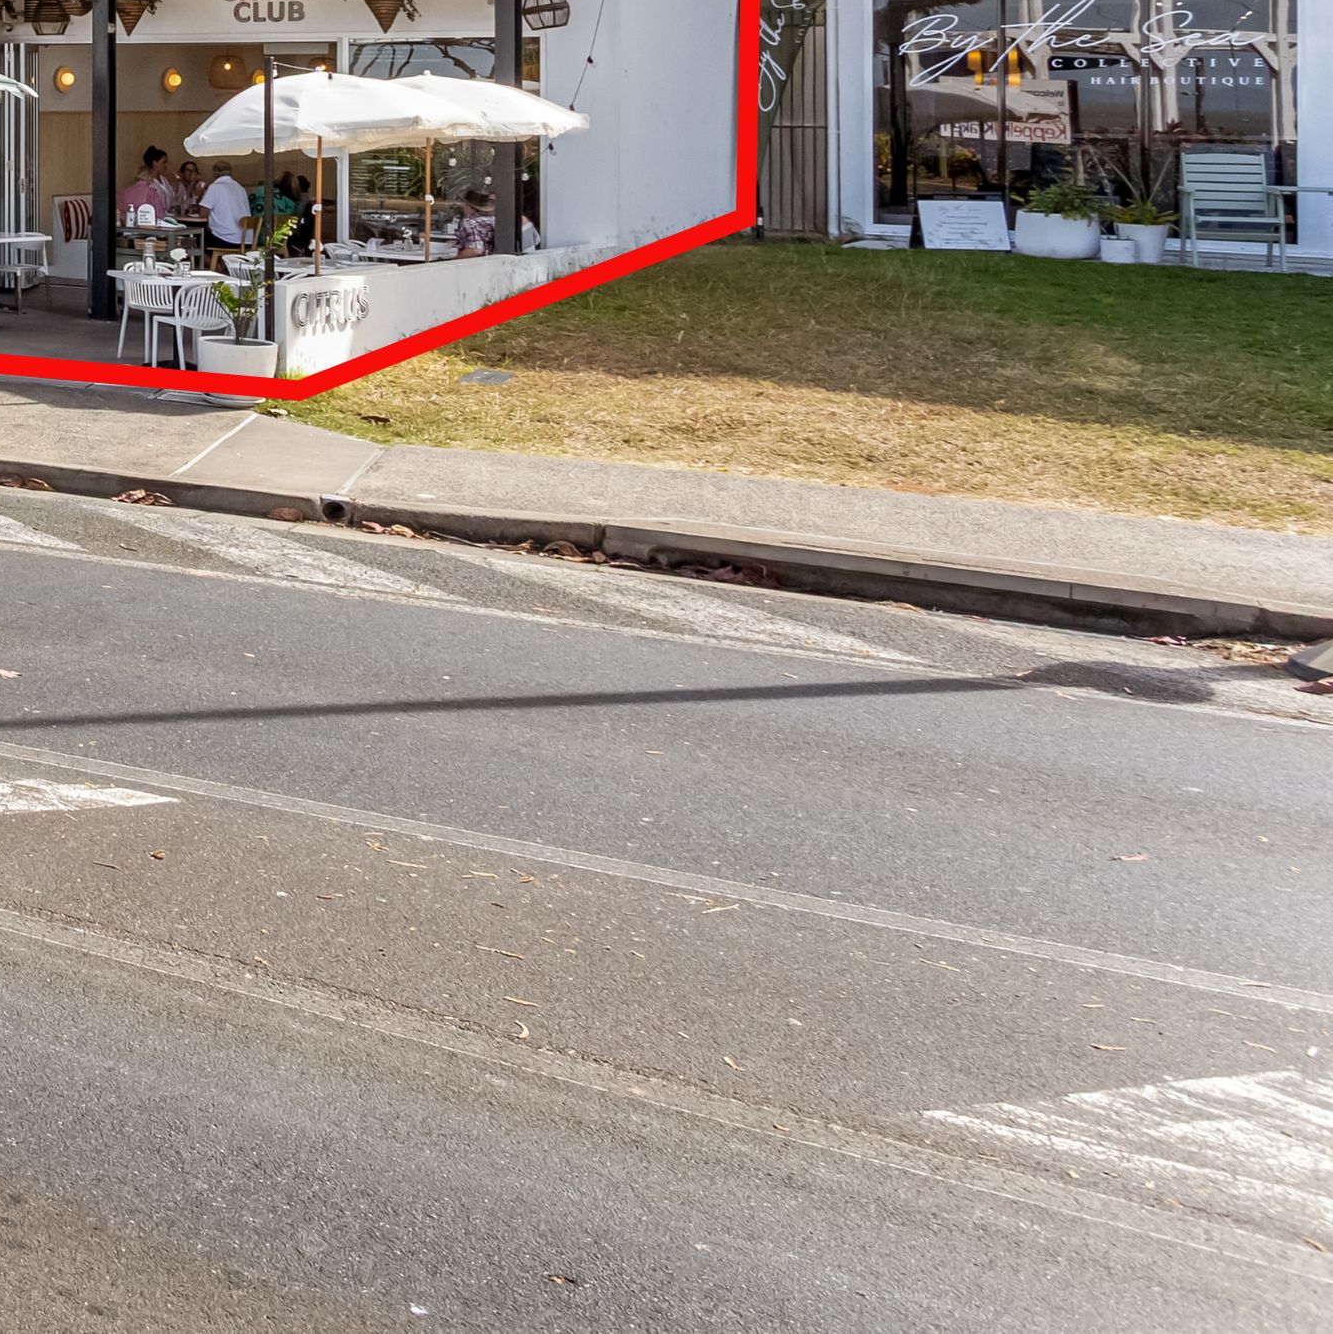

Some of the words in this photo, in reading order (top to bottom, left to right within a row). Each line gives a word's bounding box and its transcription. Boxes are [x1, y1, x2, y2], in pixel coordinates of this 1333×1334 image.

[233, 1, 305, 23] CLUB
[898, 14, 996, 87] By
[1141, 10, 1266, 53] Sea
[1051, 57, 1265, 69] COLLECTIVE
[1091, 76, 1142, 86] HAIR
[1150, 75, 1266, 87] BOUTIQUE
[291, 285, 370, 328] CITRUS
